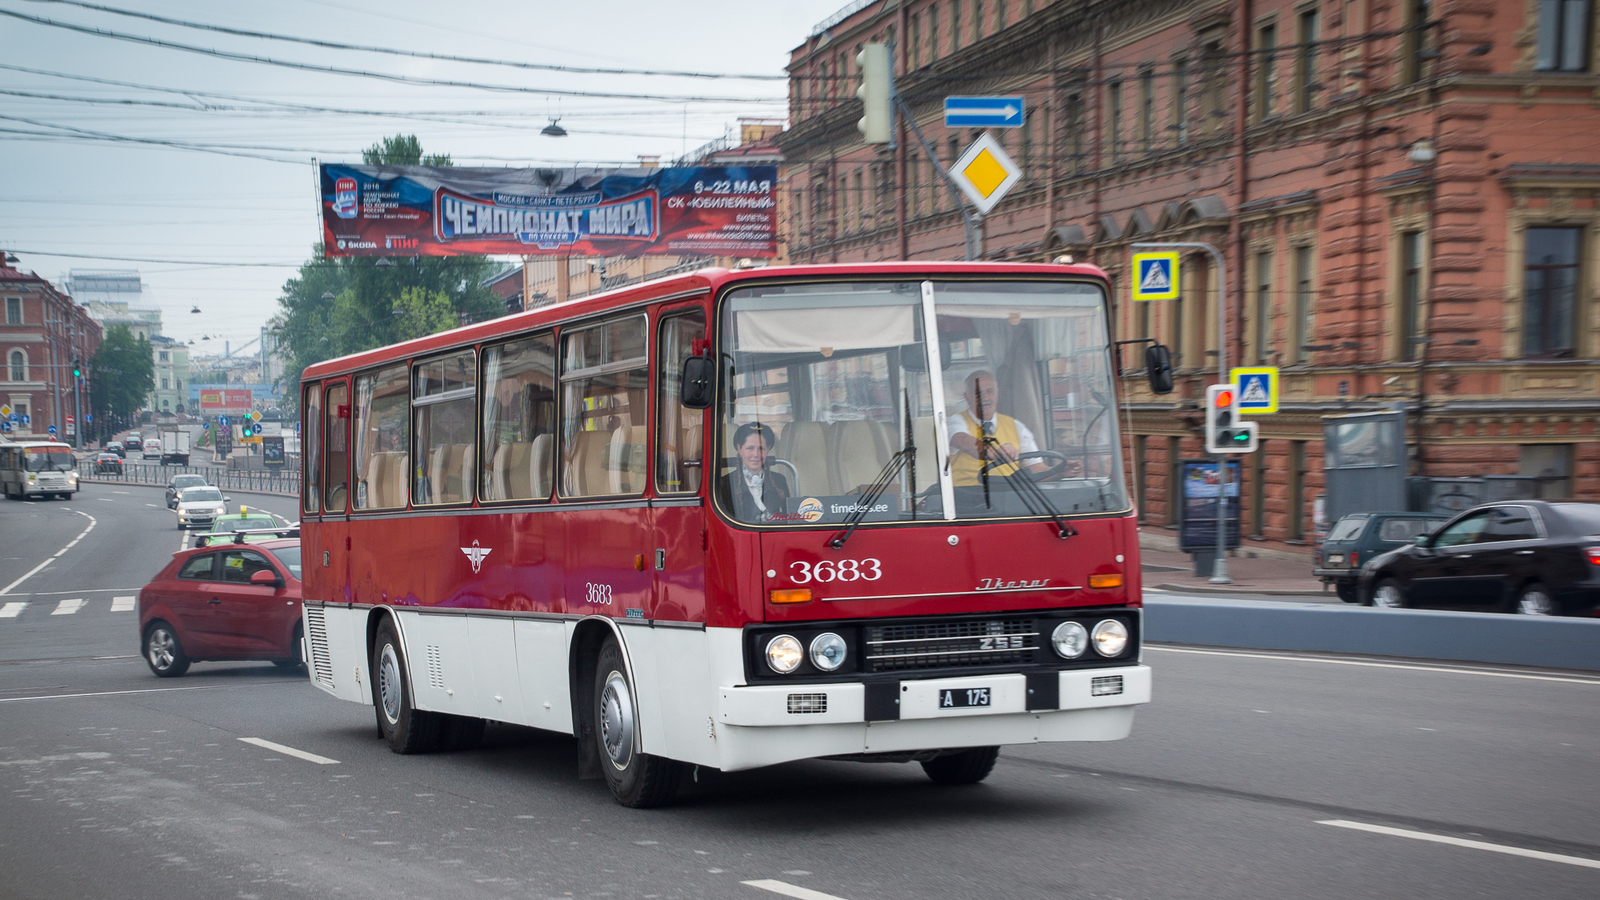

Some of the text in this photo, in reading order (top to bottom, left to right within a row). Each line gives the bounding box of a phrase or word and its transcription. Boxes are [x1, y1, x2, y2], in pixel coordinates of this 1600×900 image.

[339, 182, 354, 190] IIHF
[733, 180, 771, 194] МАЯ
[667, 196, 685, 209] СК
[445, 198, 650, 236] ЧЕМПИОНАТ МИРА
[393, 238, 419, 249] IIHF
[790, 558, 882, 584] 3683
[975, 577, 1050, 591] Ikarus
[585, 582, 612, 605] 3683
[943, 689, 988, 706] A 175
